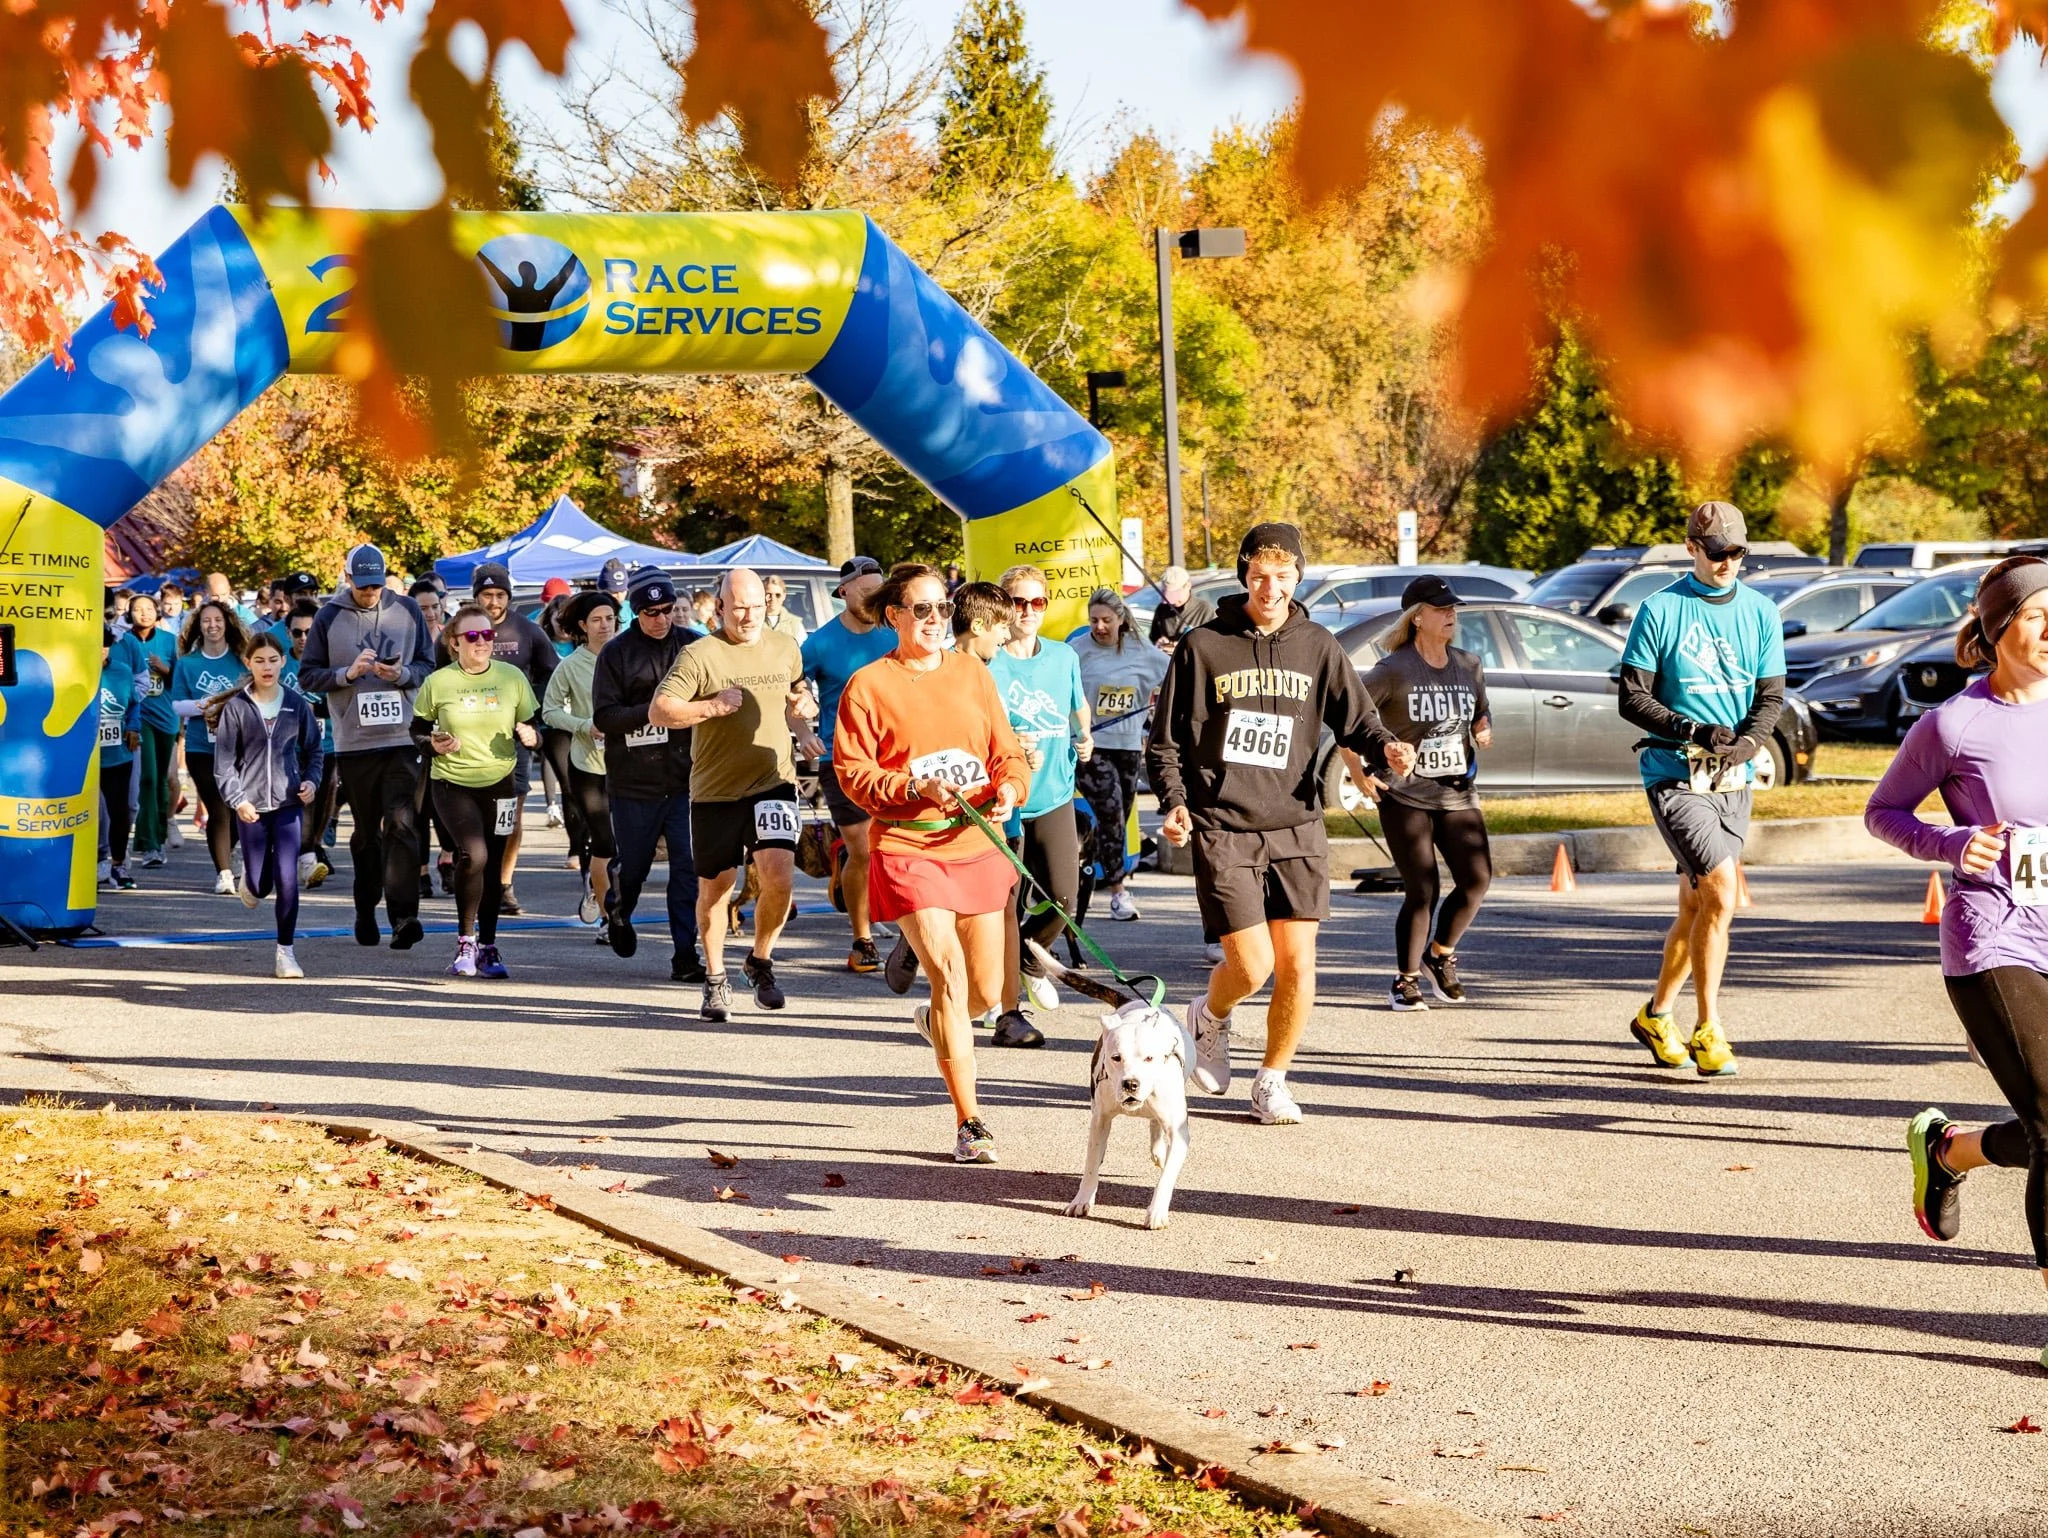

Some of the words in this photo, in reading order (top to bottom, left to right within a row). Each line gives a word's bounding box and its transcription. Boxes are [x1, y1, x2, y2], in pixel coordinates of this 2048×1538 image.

[604, 258, 739, 294] RACE
[604, 301, 822, 336] SERVICES
[1015, 540, 1065, 555] RACE
[29, 553, 90, 569] TIMING
[1045, 565, 1100, 581] EVENT
[721, 673, 791, 689] UNBREAKABL
[1215, 668, 1312, 704] PURDUE
[1098, 692, 1134, 709] 7643
[1408, 693, 1476, 722] EAGLES
[360, 702, 401, 718] 4955
[1227, 727, 1288, 757] 4966
[1417, 752, 1463, 769] 4951
[17, 802, 68, 816] RACE
[17, 810, 89, 832] SERVICES
[498, 810, 517, 828] 49
